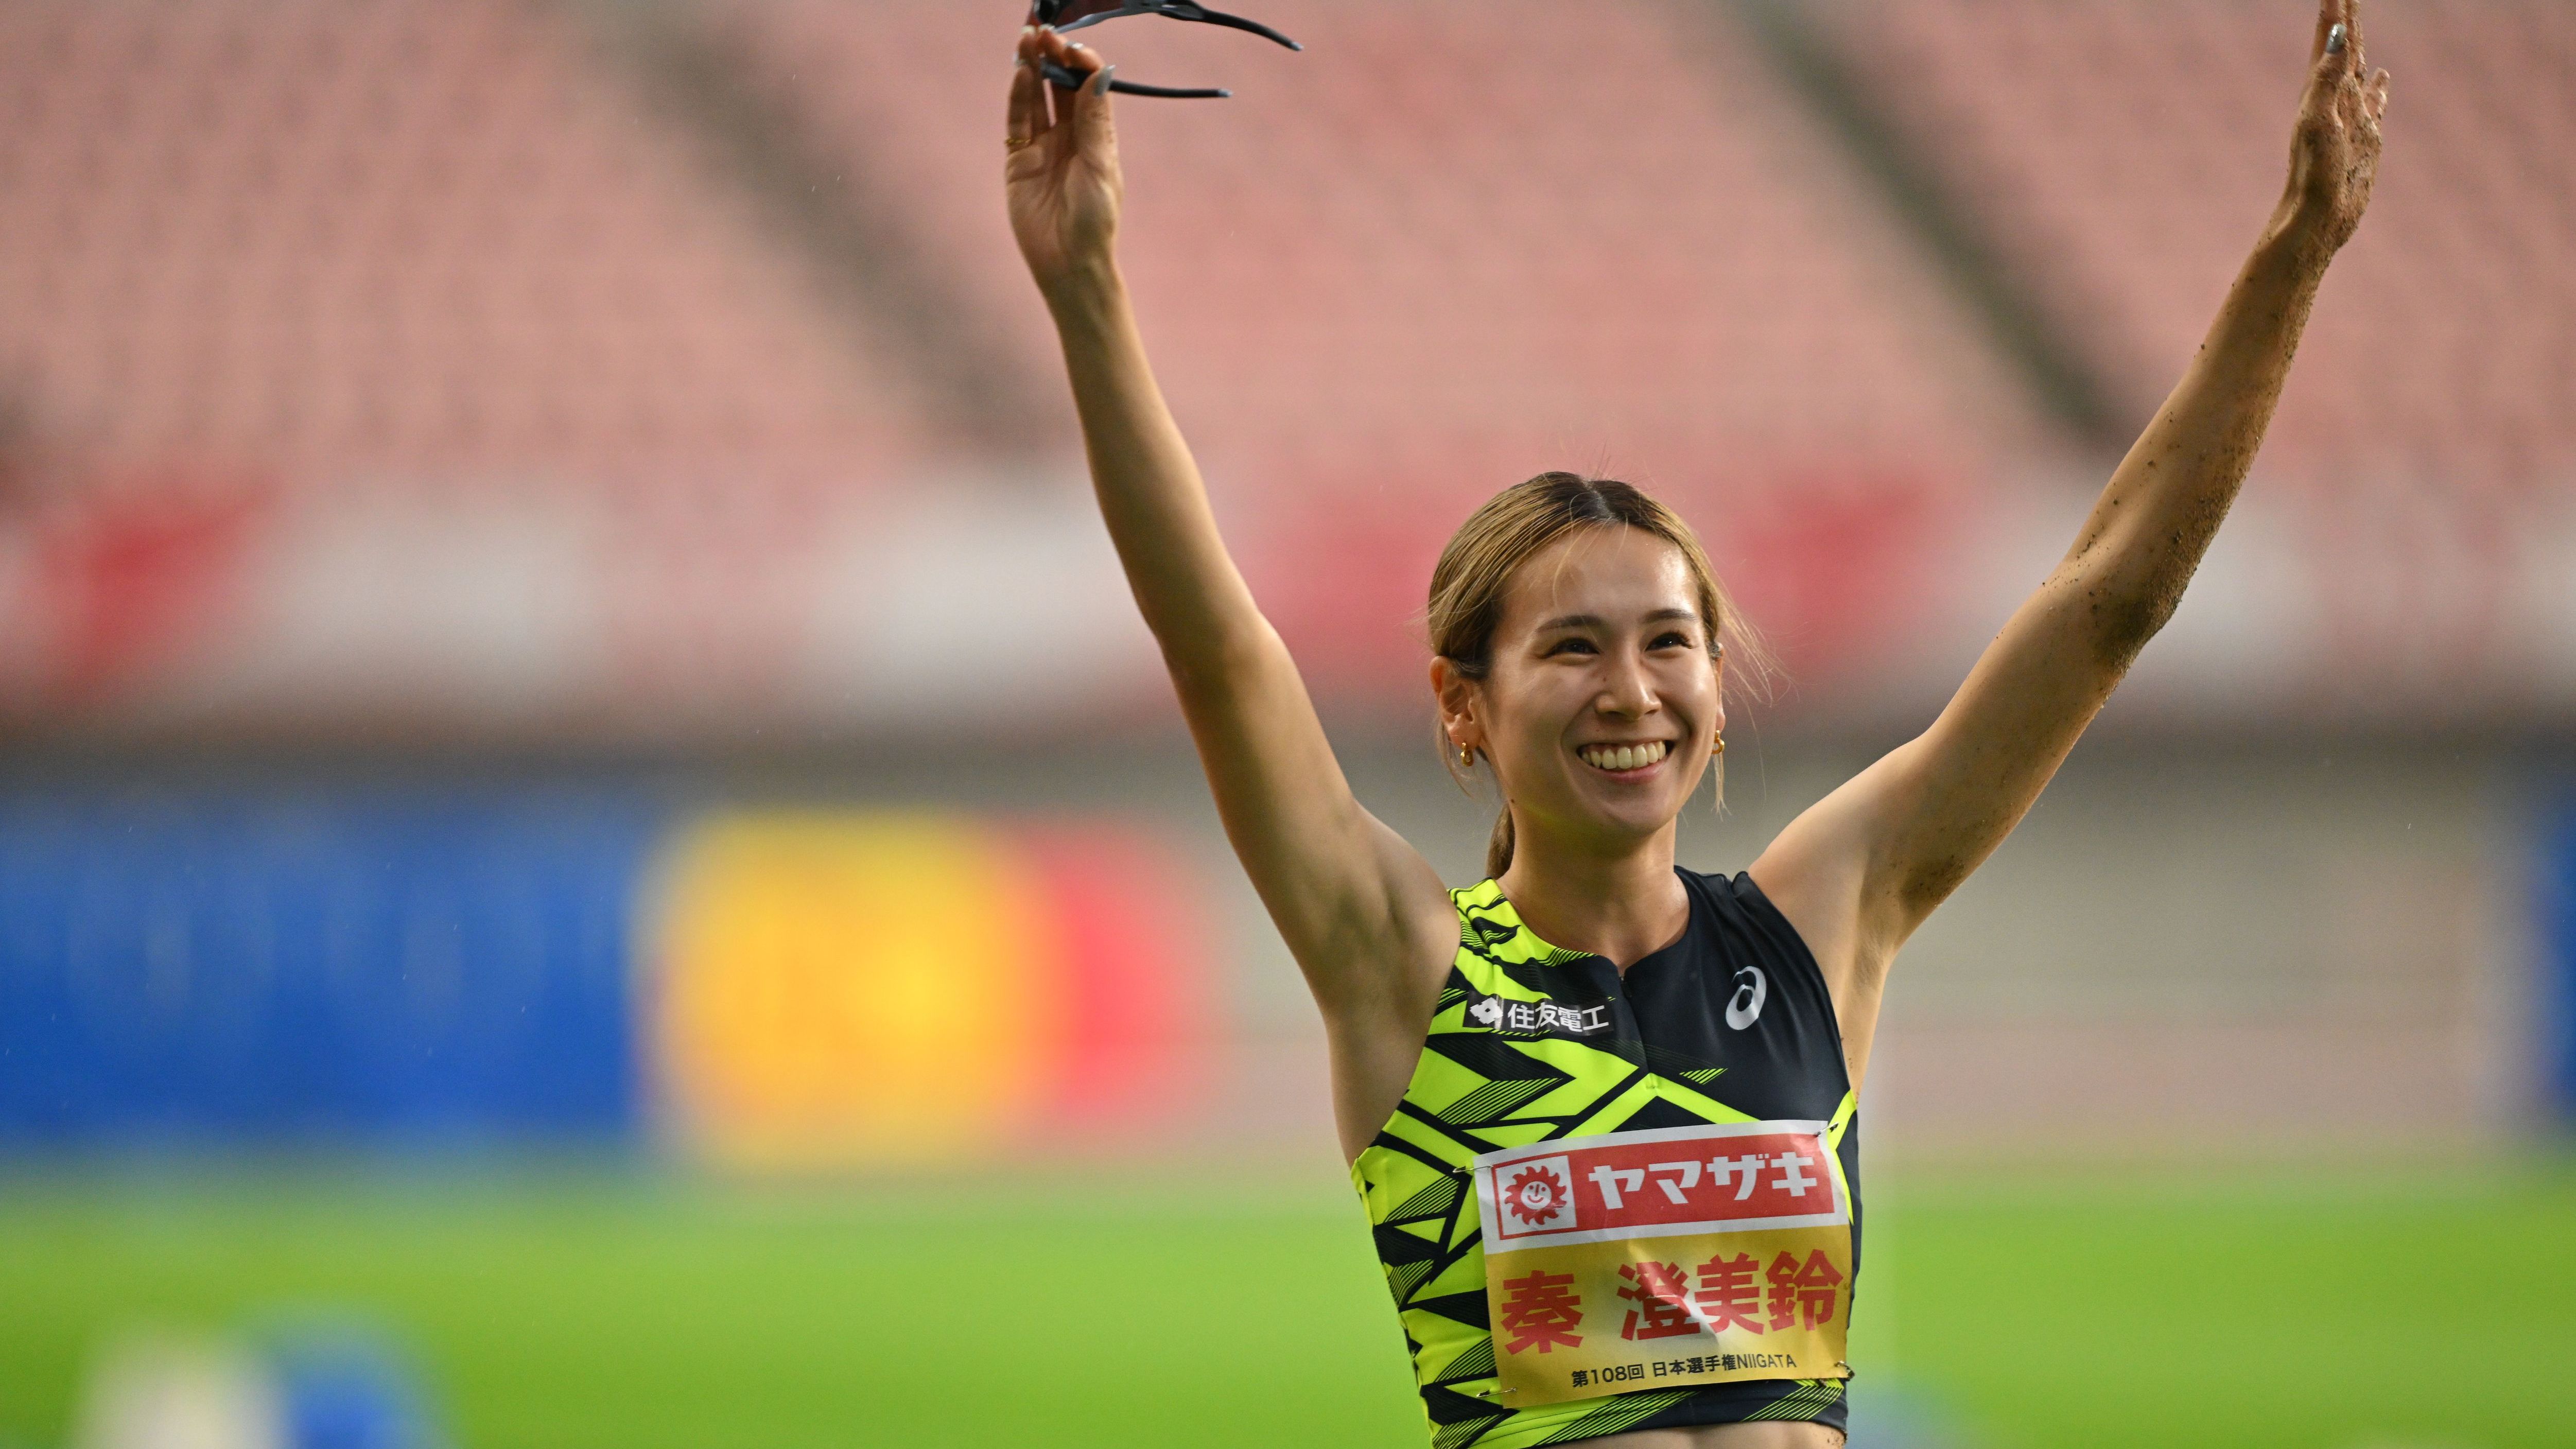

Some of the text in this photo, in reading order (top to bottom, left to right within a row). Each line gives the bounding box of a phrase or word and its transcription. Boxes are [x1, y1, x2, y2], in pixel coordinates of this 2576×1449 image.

[1507, 1002, 1609, 1032] 住友電工
[1589, 1152, 1817, 1209] ヤマザキ
[1501, 1249, 1843, 1355] 秦 澄美鈴
[1572, 1354, 1797, 1388] 第108回 日本選手権NIIGATA
